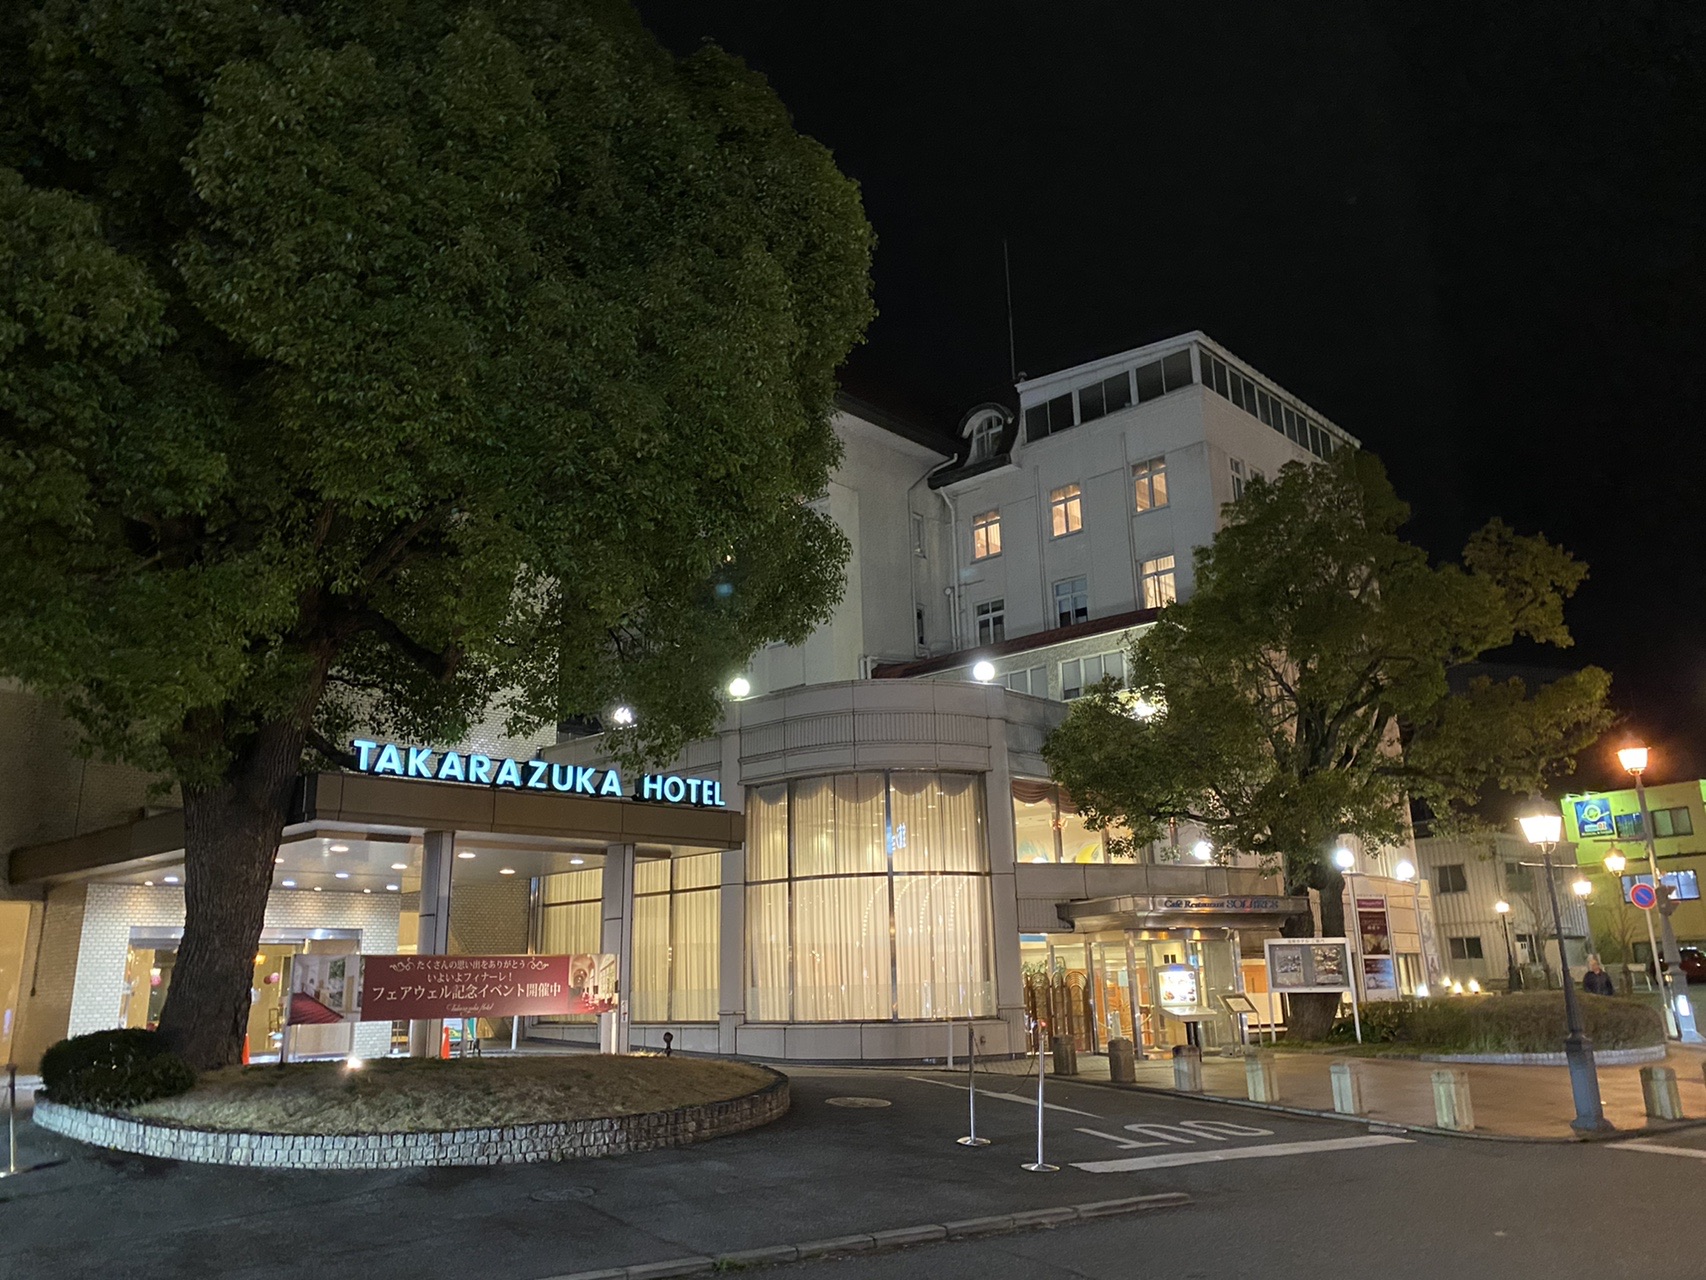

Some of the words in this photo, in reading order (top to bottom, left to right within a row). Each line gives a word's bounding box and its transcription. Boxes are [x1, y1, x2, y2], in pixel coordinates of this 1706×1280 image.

[353, 739, 622, 796] TAKARAZUKA
[642, 773, 726, 807] HOTEL
[1184, 900, 1224, 908] Restaurant
[416, 959, 527, 970] たくさんの思い出をありがとう
[372, 983, 561, 1001] フェアウェル記念イベント開催中
